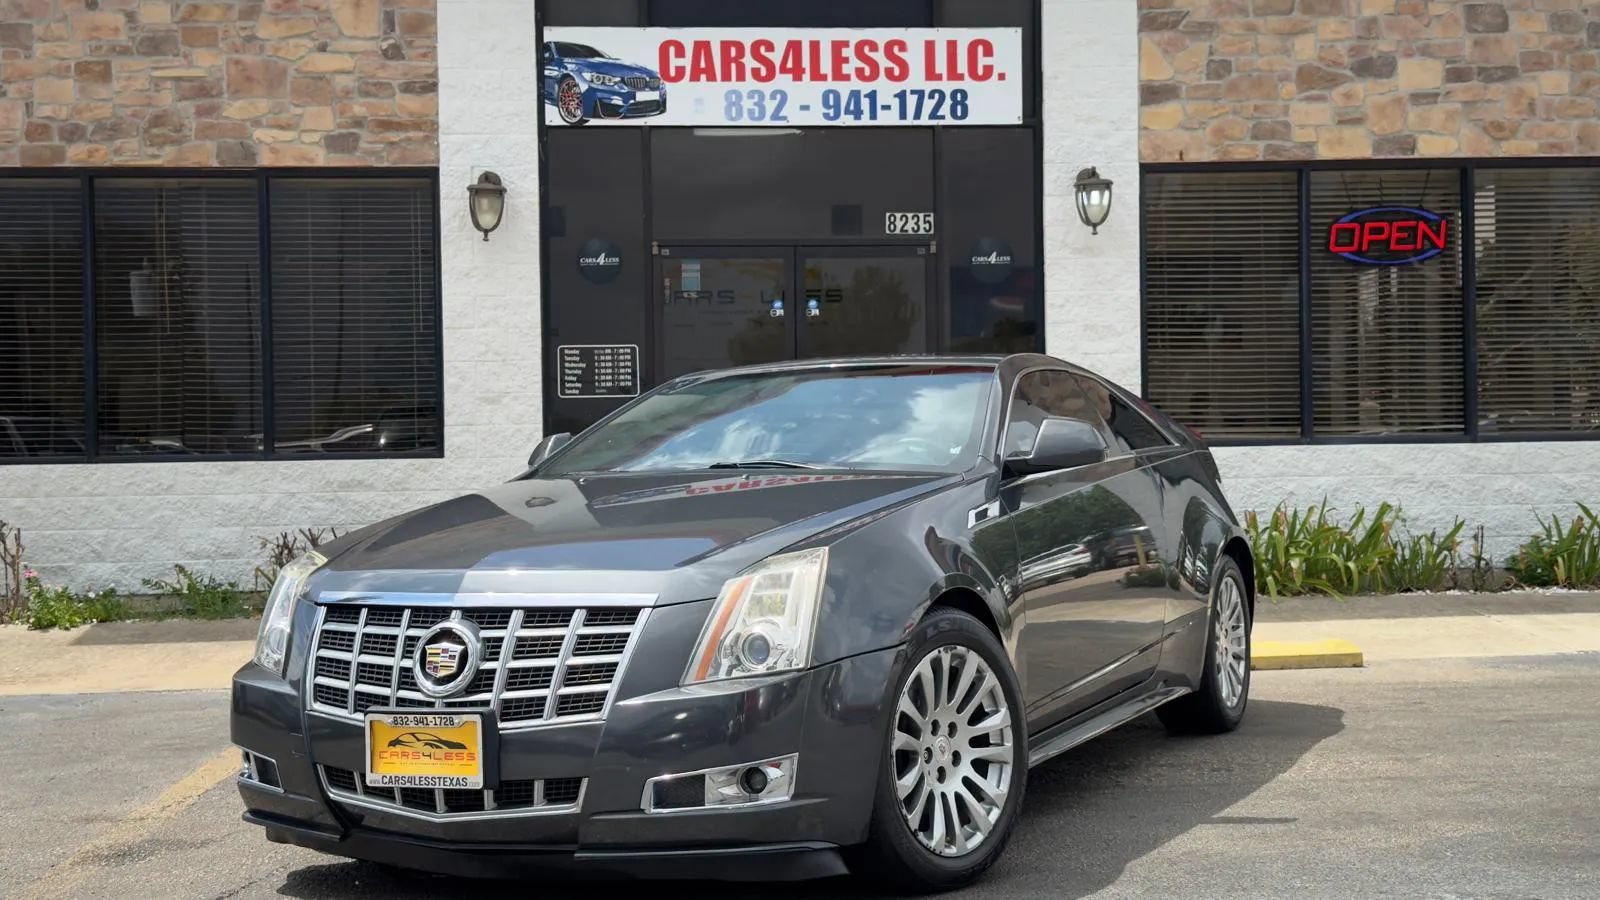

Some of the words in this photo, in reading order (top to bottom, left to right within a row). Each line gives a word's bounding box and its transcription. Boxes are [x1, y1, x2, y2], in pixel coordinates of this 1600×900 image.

[658, 39, 910, 83] CARS4LESS
[924, 39, 1006, 83] LLC.
[724, 89, 789, 122] 832
[821, 88, 969, 121] 941-1728
[887, 213, 933, 233] 8235
[1329, 219, 1447, 252] OPEN
[392, 716, 455, 726] 832-941-1728
[378, 750, 477, 761] CARS4LESS
[381, 775, 468, 787] CARS4LESSTEXAS
